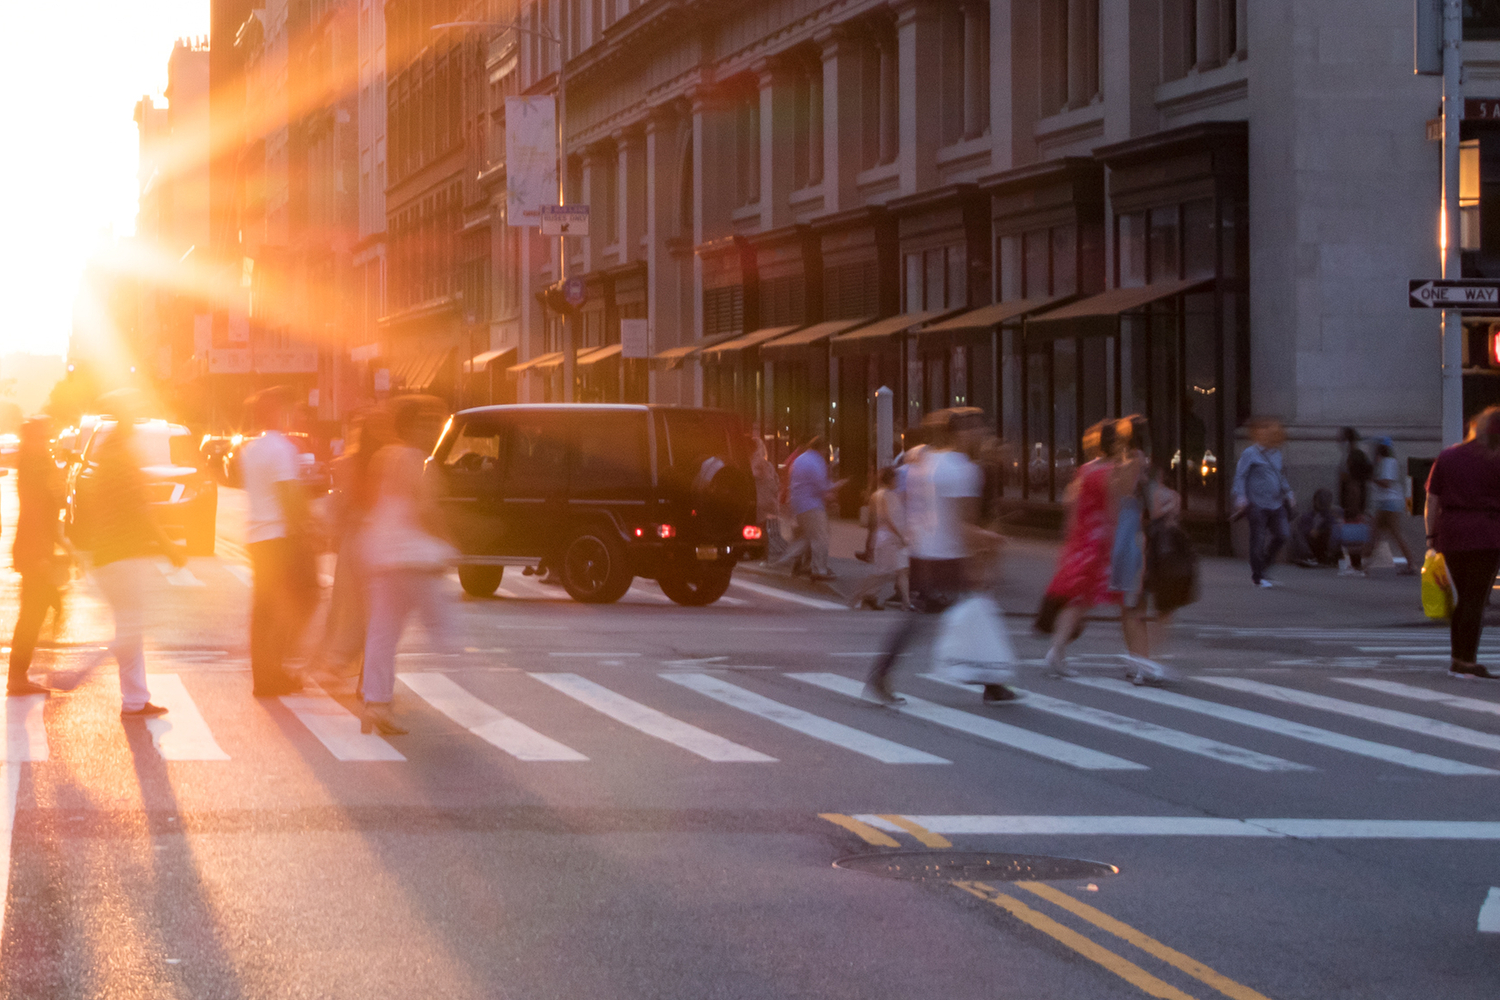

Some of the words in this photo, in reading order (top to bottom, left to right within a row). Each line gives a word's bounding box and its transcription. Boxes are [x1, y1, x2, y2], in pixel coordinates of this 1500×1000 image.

[1480, 102, 1487, 118] 5
[1421, 288, 1449, 300] ONE
[1465, 288, 1495, 300] WAY
